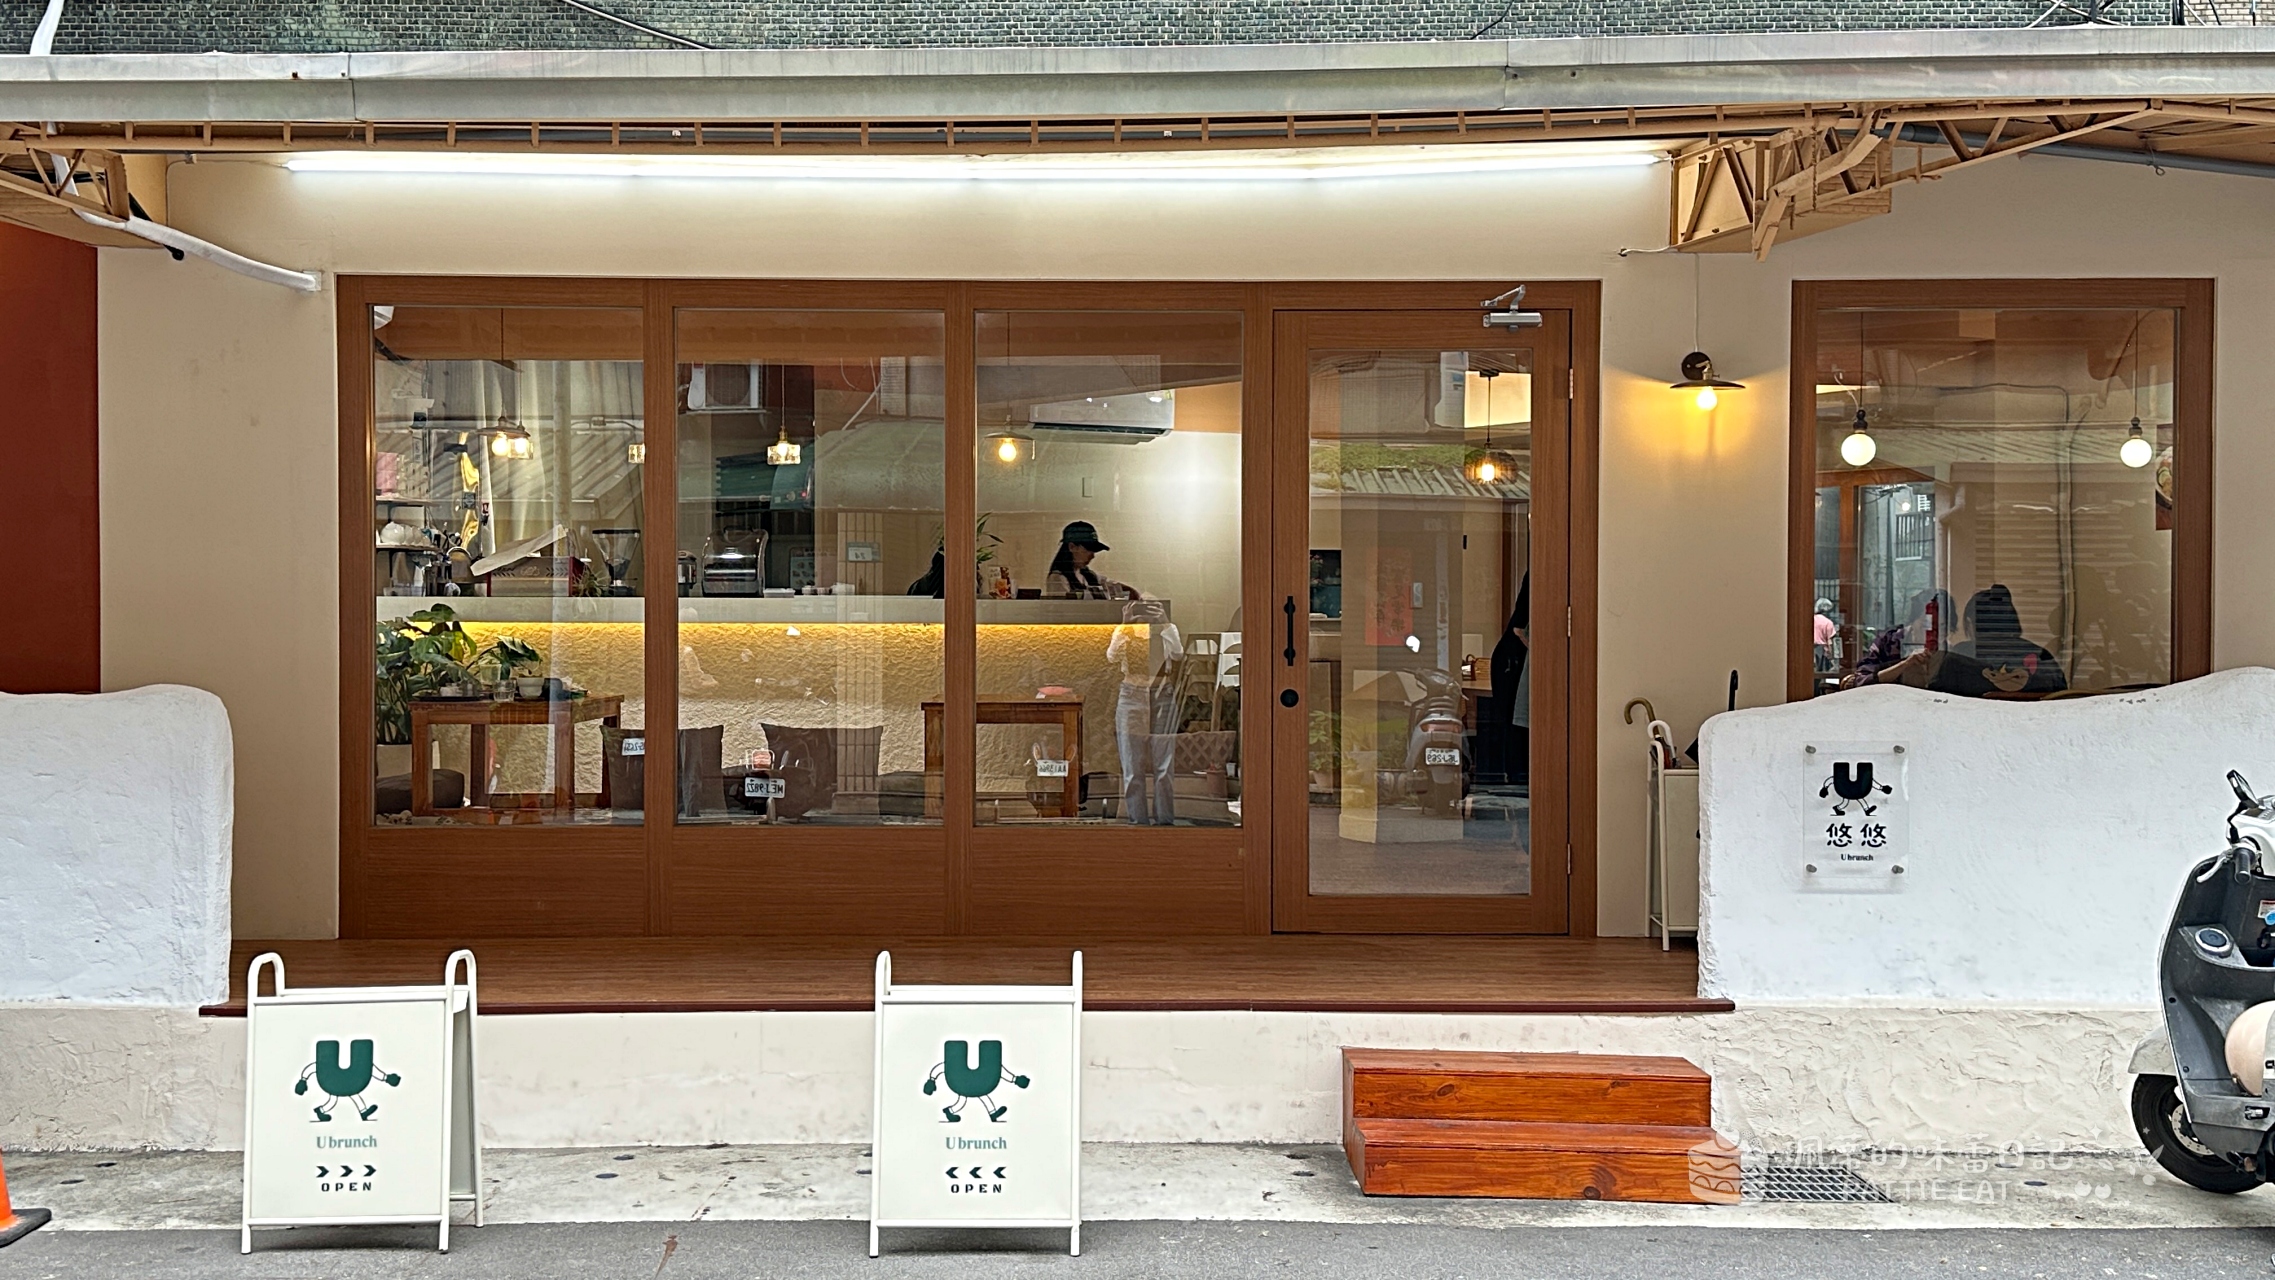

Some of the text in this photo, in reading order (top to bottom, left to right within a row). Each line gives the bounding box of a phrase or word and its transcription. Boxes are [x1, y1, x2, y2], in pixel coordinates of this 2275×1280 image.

[1833, 762, 1873, 800] U
[316, 1039, 374, 1097] U
[944, 1040, 1002, 1098] U
[321, 1181, 372, 1192] OPEN
[951, 1183, 1002, 1194] OPEN
